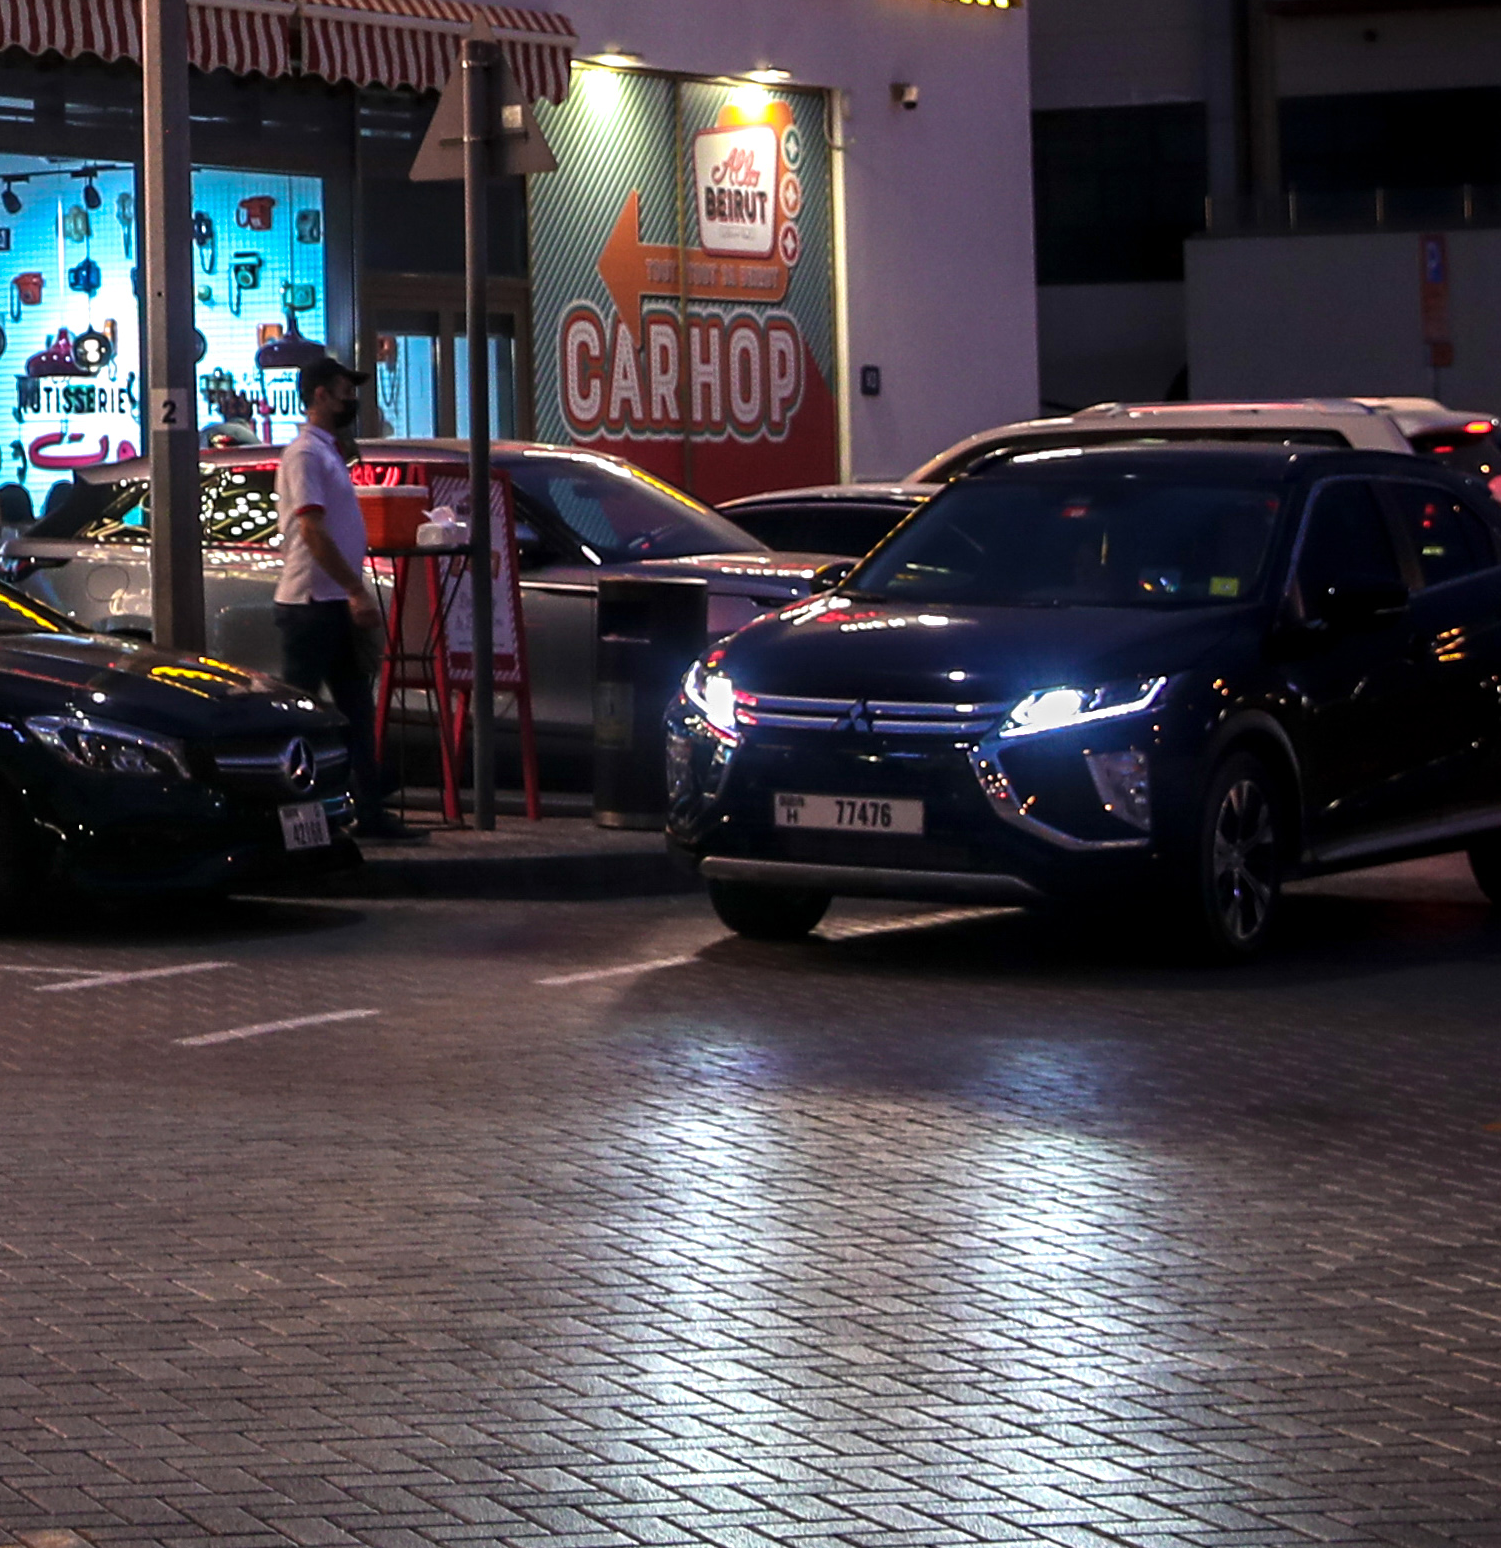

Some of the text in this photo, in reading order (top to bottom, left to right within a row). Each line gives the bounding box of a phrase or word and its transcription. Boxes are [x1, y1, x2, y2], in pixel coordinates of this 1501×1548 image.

[704, 185, 768, 225] BEIRUT
[564, 316, 798, 426] CARHOP
[162, 400, 177, 424] 2
[835, 800, 892, 828] 77476
